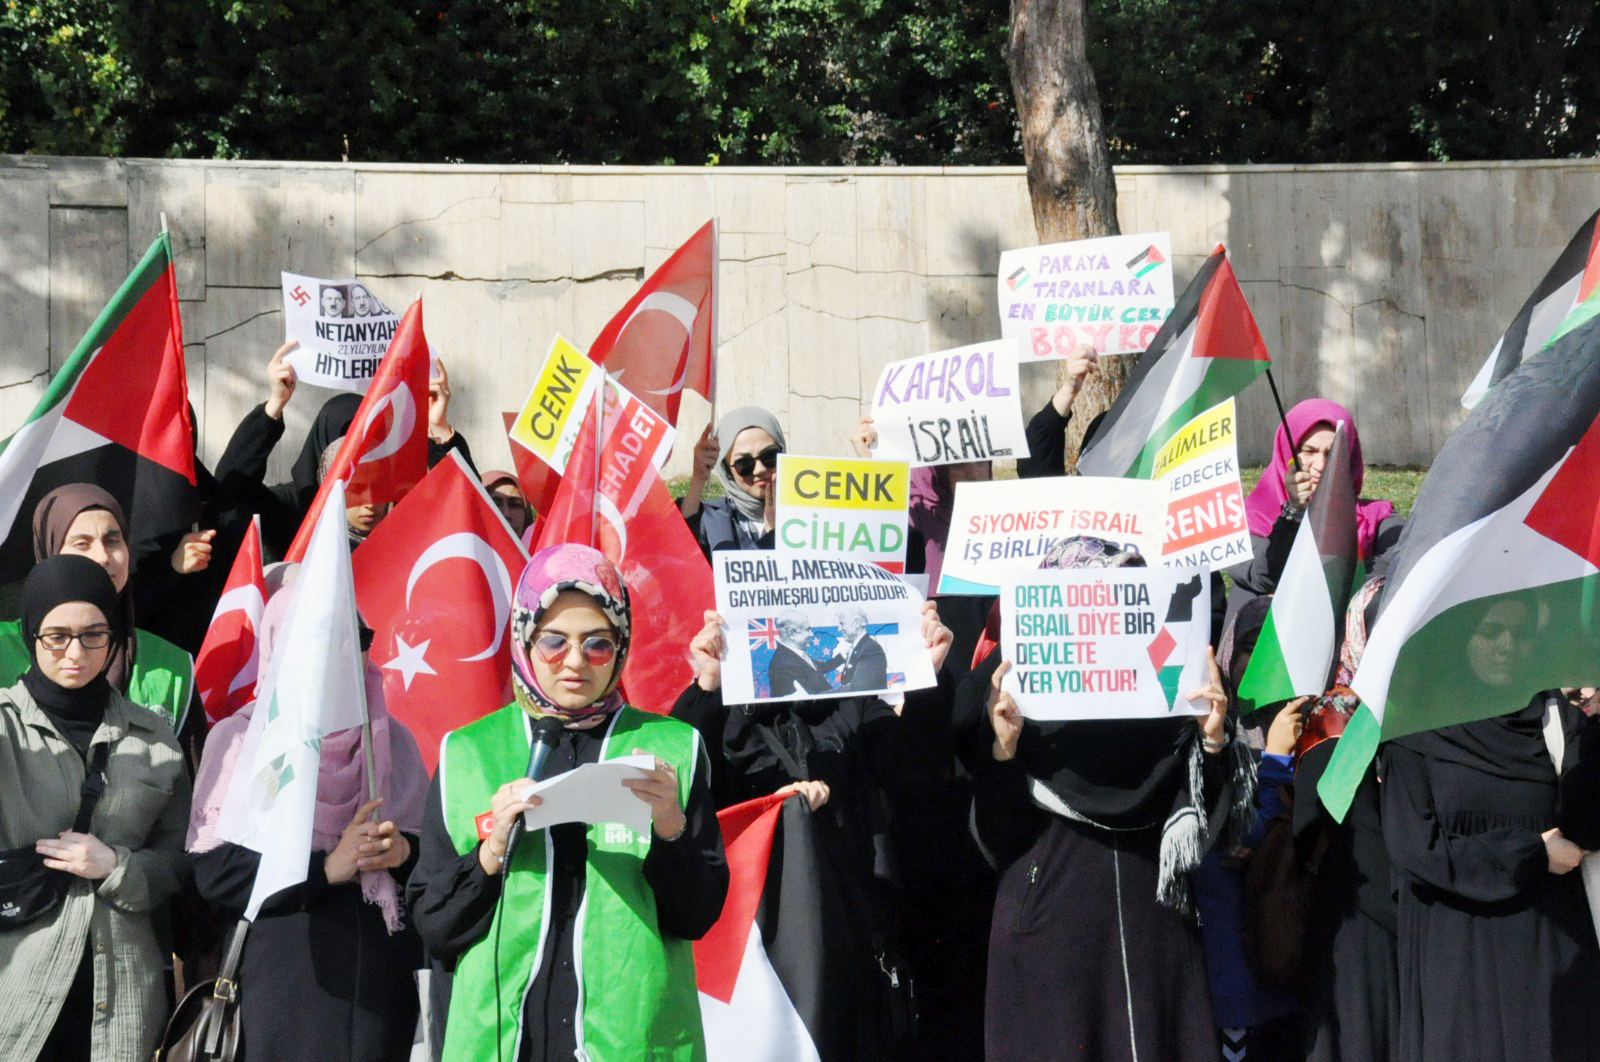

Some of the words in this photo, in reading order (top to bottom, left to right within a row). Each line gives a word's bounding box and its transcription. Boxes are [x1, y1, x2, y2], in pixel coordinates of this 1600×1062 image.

[1039, 254, 1110, 274] PARAYA
[1033, 279, 1156, 298] TAPANLARA
[1008, 303, 1036, 321] EN
[1045, 303, 1115, 322] BÜYÜK
[315, 320, 399, 342] NETANYAH
[1031, 323, 1160, 356] BOYKO
[315, 352, 382, 379] HİTLERİ
[878, 352, 1011, 406] KAHROL
[530, 354, 582, 441] CENK
[908, 409, 1014, 462] İSRAİL
[600, 405, 657, 500] EHADET
[794, 469, 895, 502] CENK
[1170, 458, 1233, 492] EDECEK
[781, 513, 903, 553] CİHAD
[963, 539, 983, 565] İŞ
[724, 556, 788, 584] İSRAİL,
[729, 586, 819, 609] GAYRİMEŞRU
[822, 581, 909, 607] ÇOCUĞUDUR!
[1015, 584, 1063, 608] ORTA
[1067, 579, 1150, 607] DOĞU'DA
[1078, 608, 1120, 636] DİYE
[1124, 607, 1155, 635] BİR
[1016, 641, 1097, 665] DEVLETE
[1017, 670, 1052, 694] YER
[1056, 668, 1137, 693] YOKTUR!
